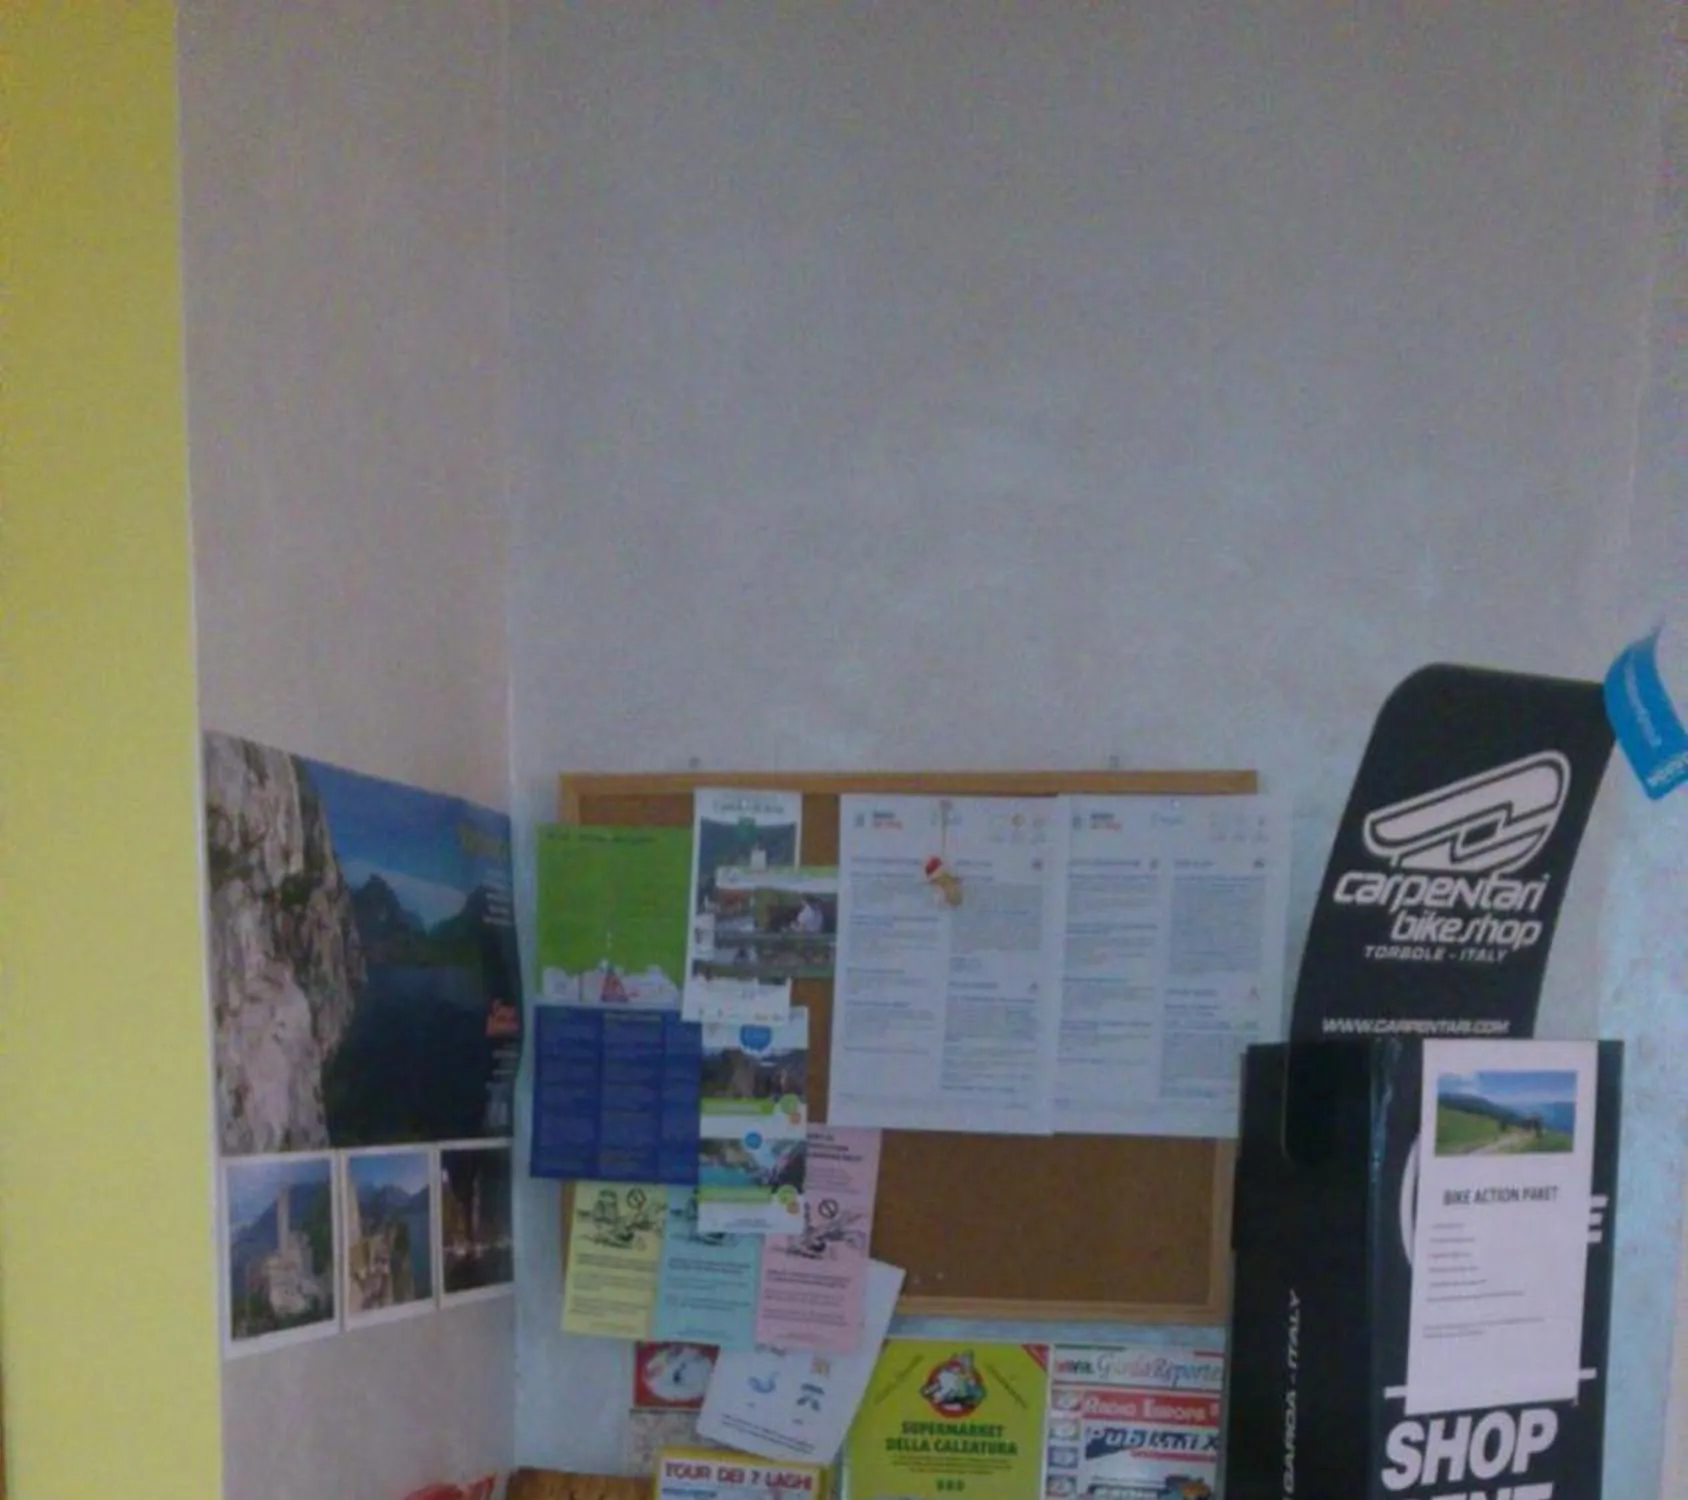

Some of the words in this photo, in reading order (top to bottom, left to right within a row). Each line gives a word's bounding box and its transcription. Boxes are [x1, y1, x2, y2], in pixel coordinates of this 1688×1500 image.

[1362, 945, 1445, 962] TORBOLE
[1459, 946, 1509, 963] ITALY
[1443, 1187, 1471, 1206] BIKE
[1474, 1185, 1520, 1204] ACTION
[1287, 1288, 1301, 1370] ITALY
[1282, 1389, 1298, 1494] GARDA
[1382, 1408, 1559, 1491] SHOP
[664, 1460, 711, 1481] TOUR
